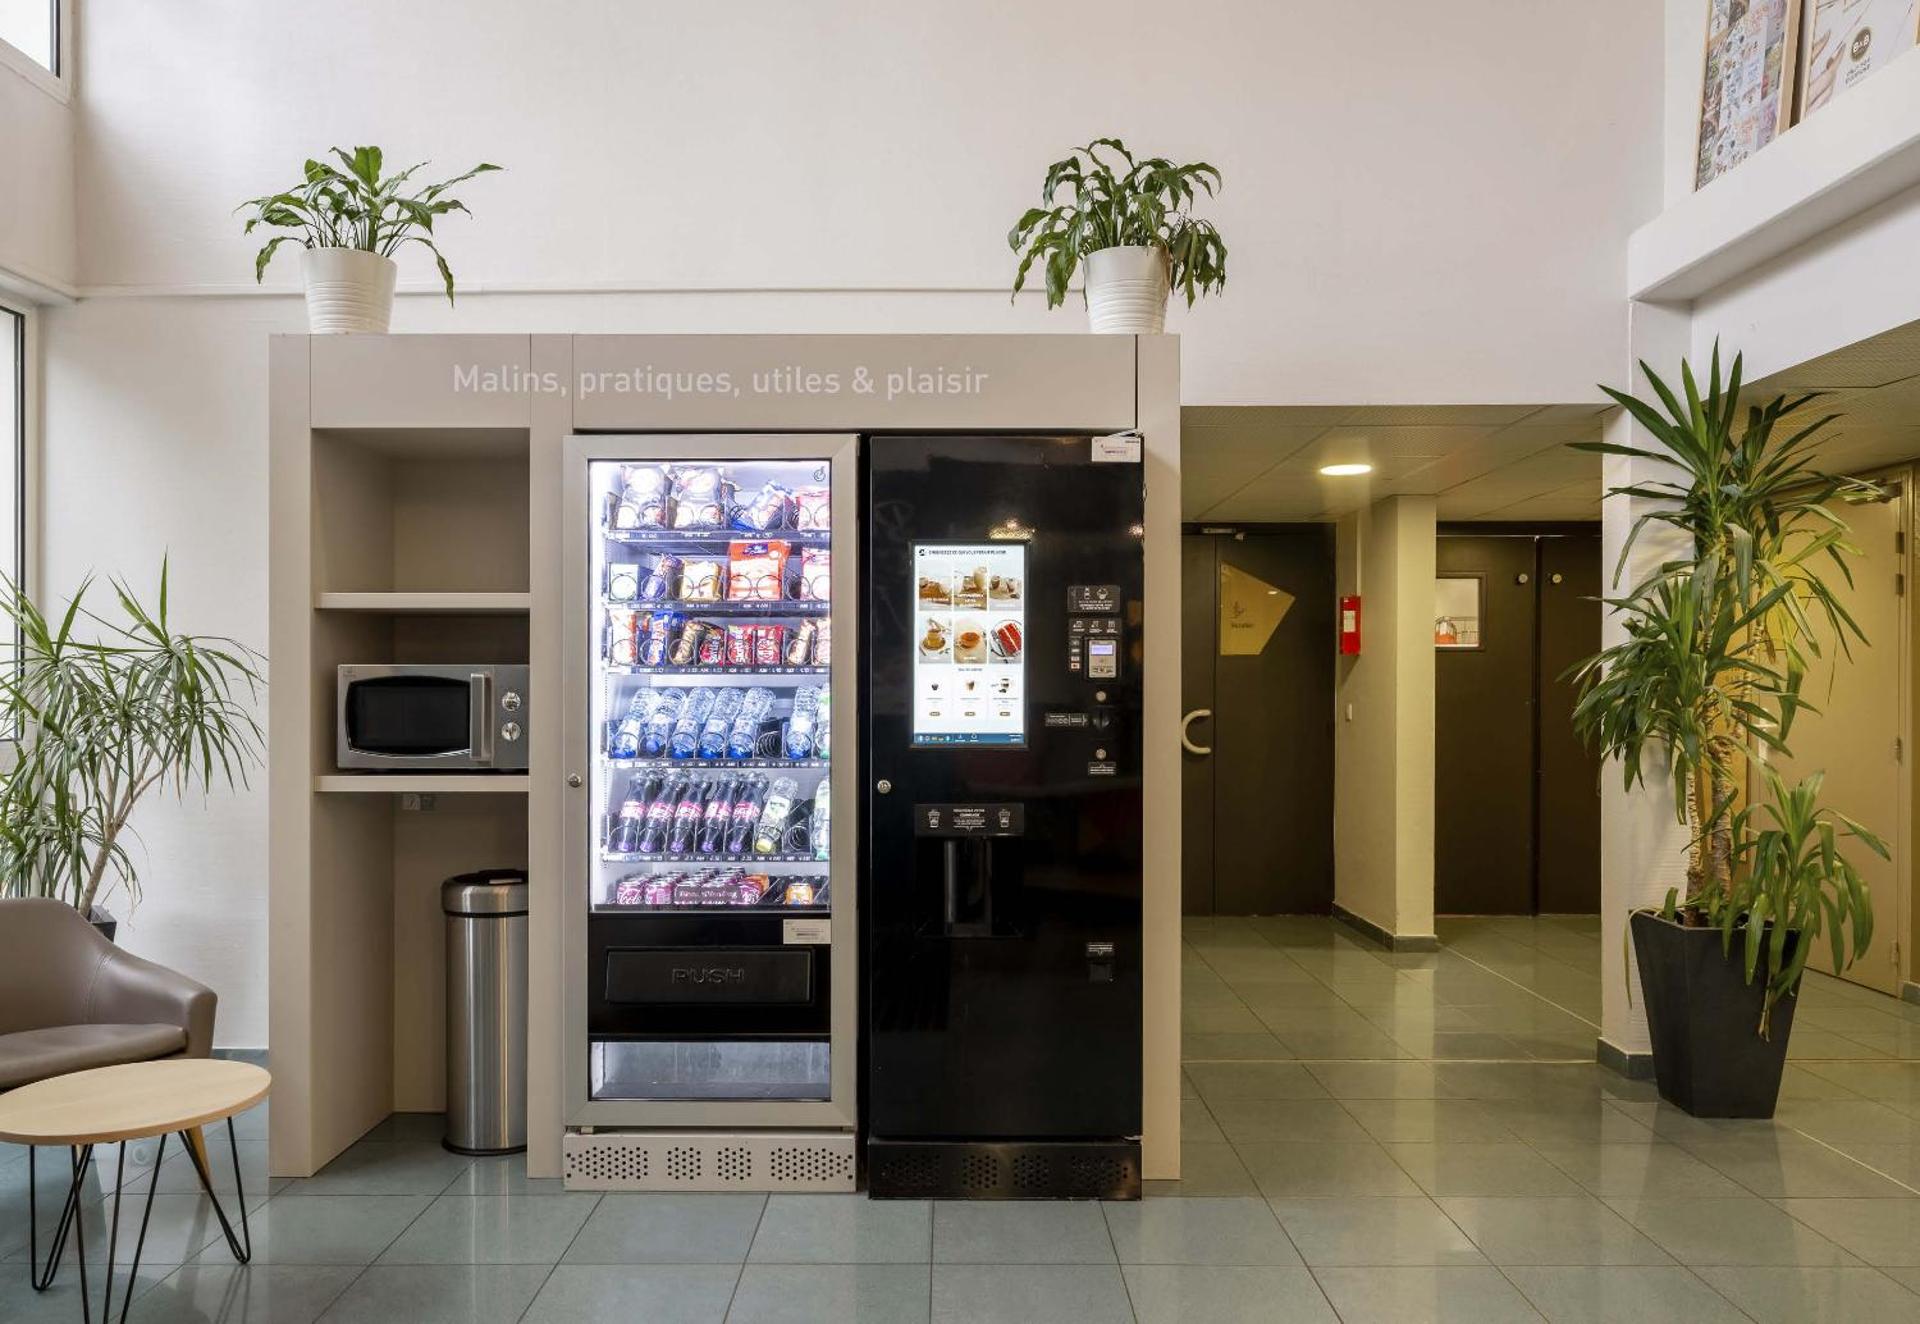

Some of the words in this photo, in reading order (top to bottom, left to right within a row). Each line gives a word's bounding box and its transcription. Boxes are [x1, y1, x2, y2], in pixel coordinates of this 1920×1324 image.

[453, 364, 567, 398] Malins,
[579, 365, 740, 400] pratiques,
[753, 366, 841, 394] utiles
[851, 366, 875, 394] &
[887, 366, 989, 400] plaisir
[672, 967, 745, 984] PUSH
